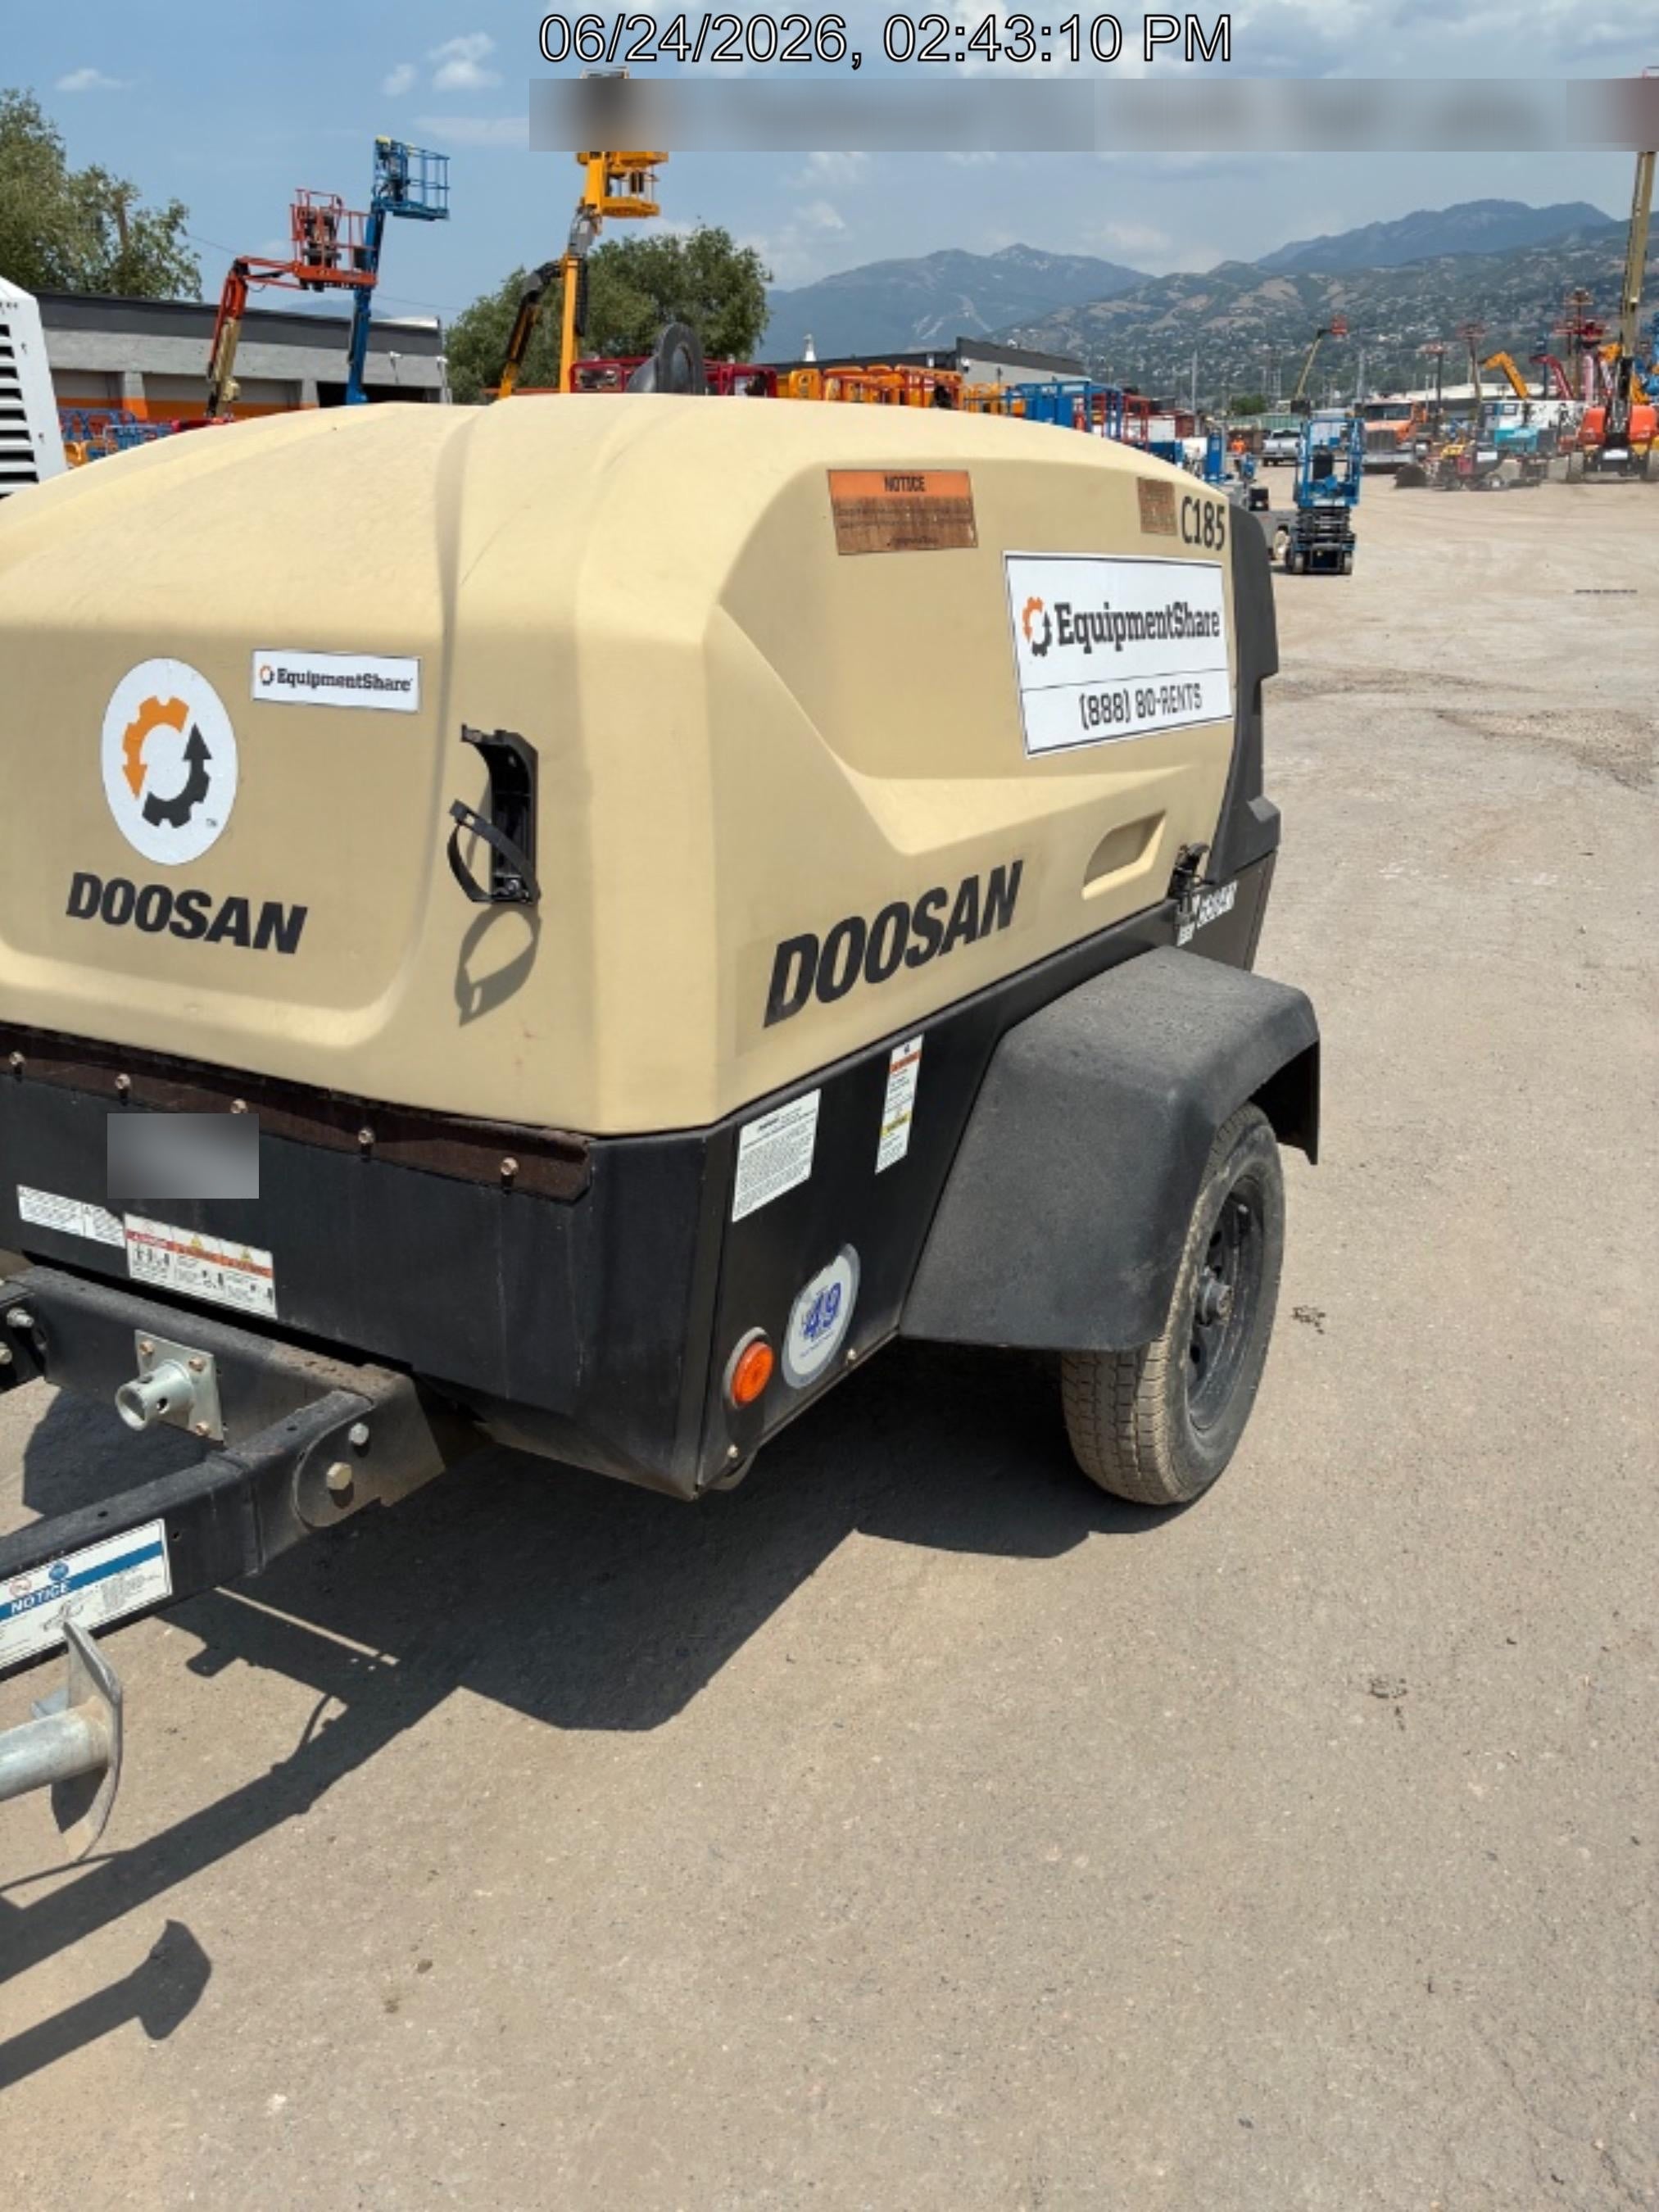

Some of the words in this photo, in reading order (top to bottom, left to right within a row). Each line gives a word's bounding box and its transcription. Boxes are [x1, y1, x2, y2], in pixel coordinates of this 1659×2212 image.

[884, 476, 926, 492] NOTICE
[1181, 495, 1226, 551] C185
[1054, 601, 1221, 654] EquipmentShare
[276, 667, 412, 693] EquipmentShare
[1079, 687, 1131, 731] (888)
[1135, 682, 1203, 719] 80-RENTS
[66, 872, 308, 954] DOOSAN
[763, 860, 1024, 1029] DOOSAN
[11, 1580, 70, 1616] NOTICE
